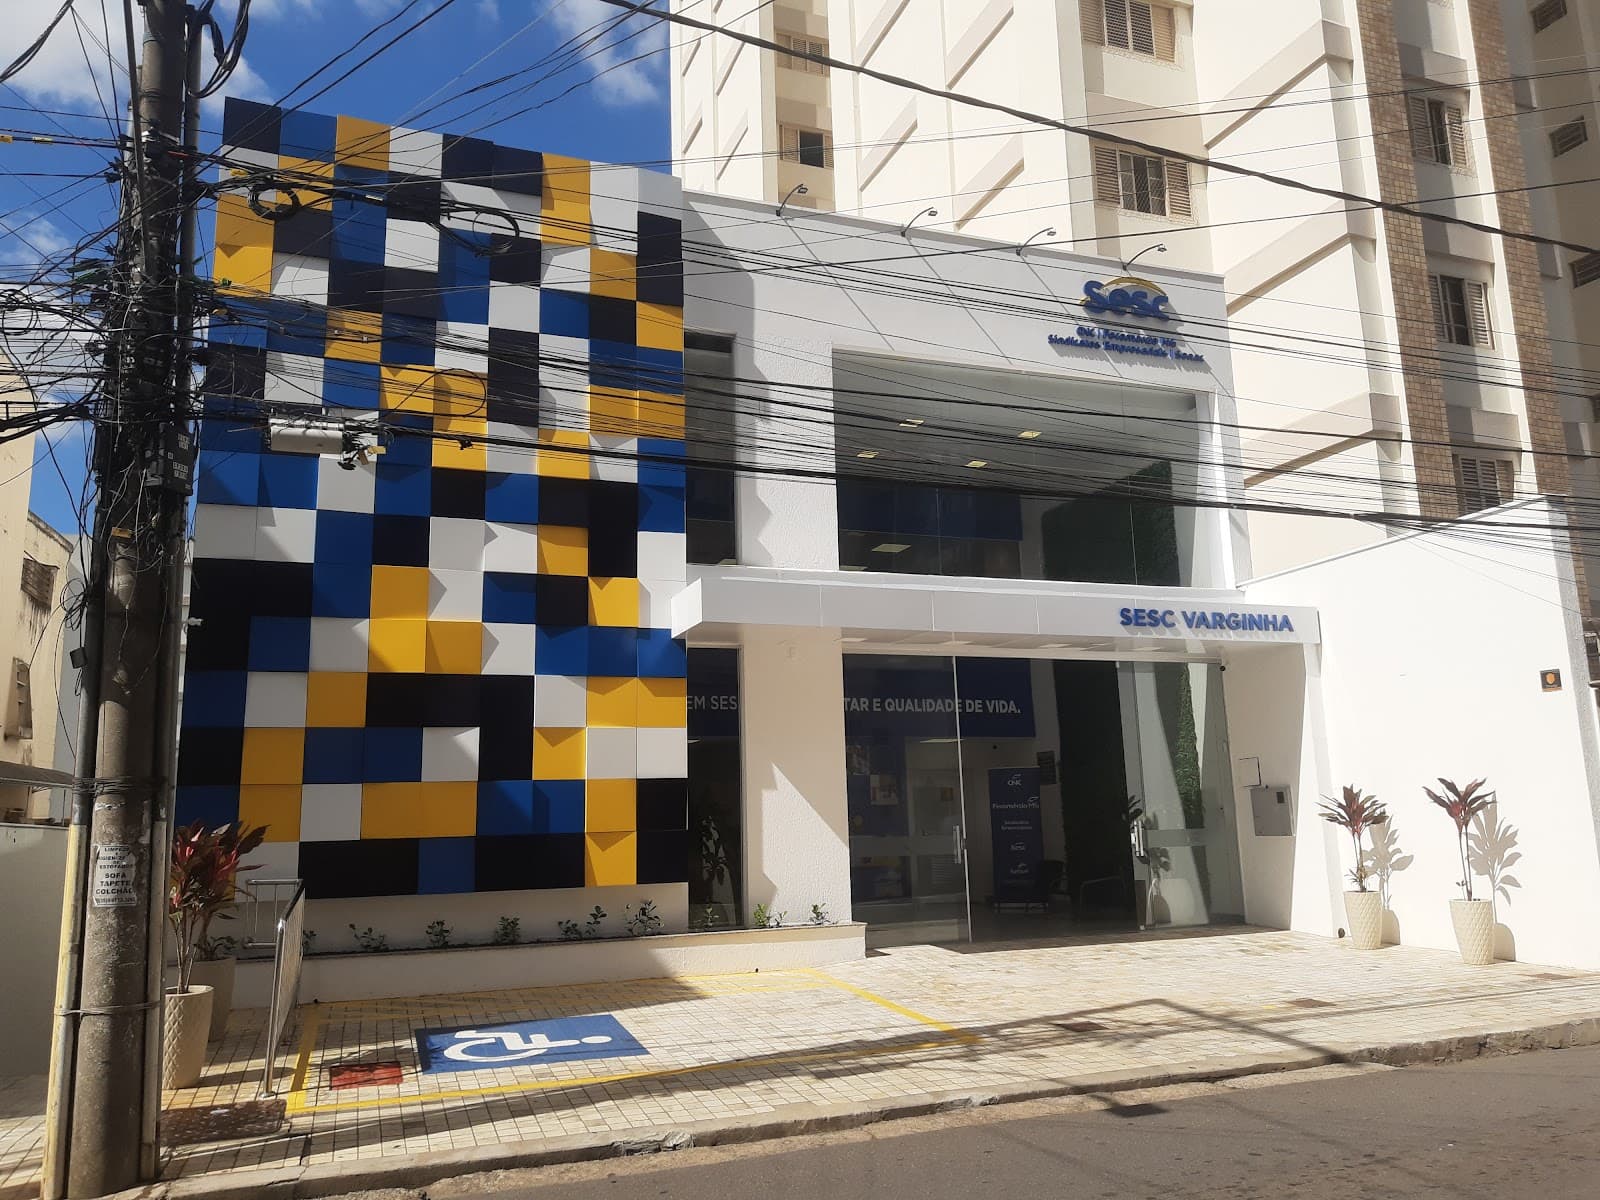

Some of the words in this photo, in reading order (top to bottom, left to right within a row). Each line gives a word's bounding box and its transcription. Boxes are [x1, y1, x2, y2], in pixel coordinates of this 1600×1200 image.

[1083, 280, 1170, 322] Sesc
[1120, 607, 1177, 628] SESC
[1181, 610, 1295, 632] VARGINHA
[873, 698, 881, 712] E
[884, 698, 962, 713] QUALIDADE
[965, 699, 983, 713] DE
[986, 699, 1021, 714] VIDA.
